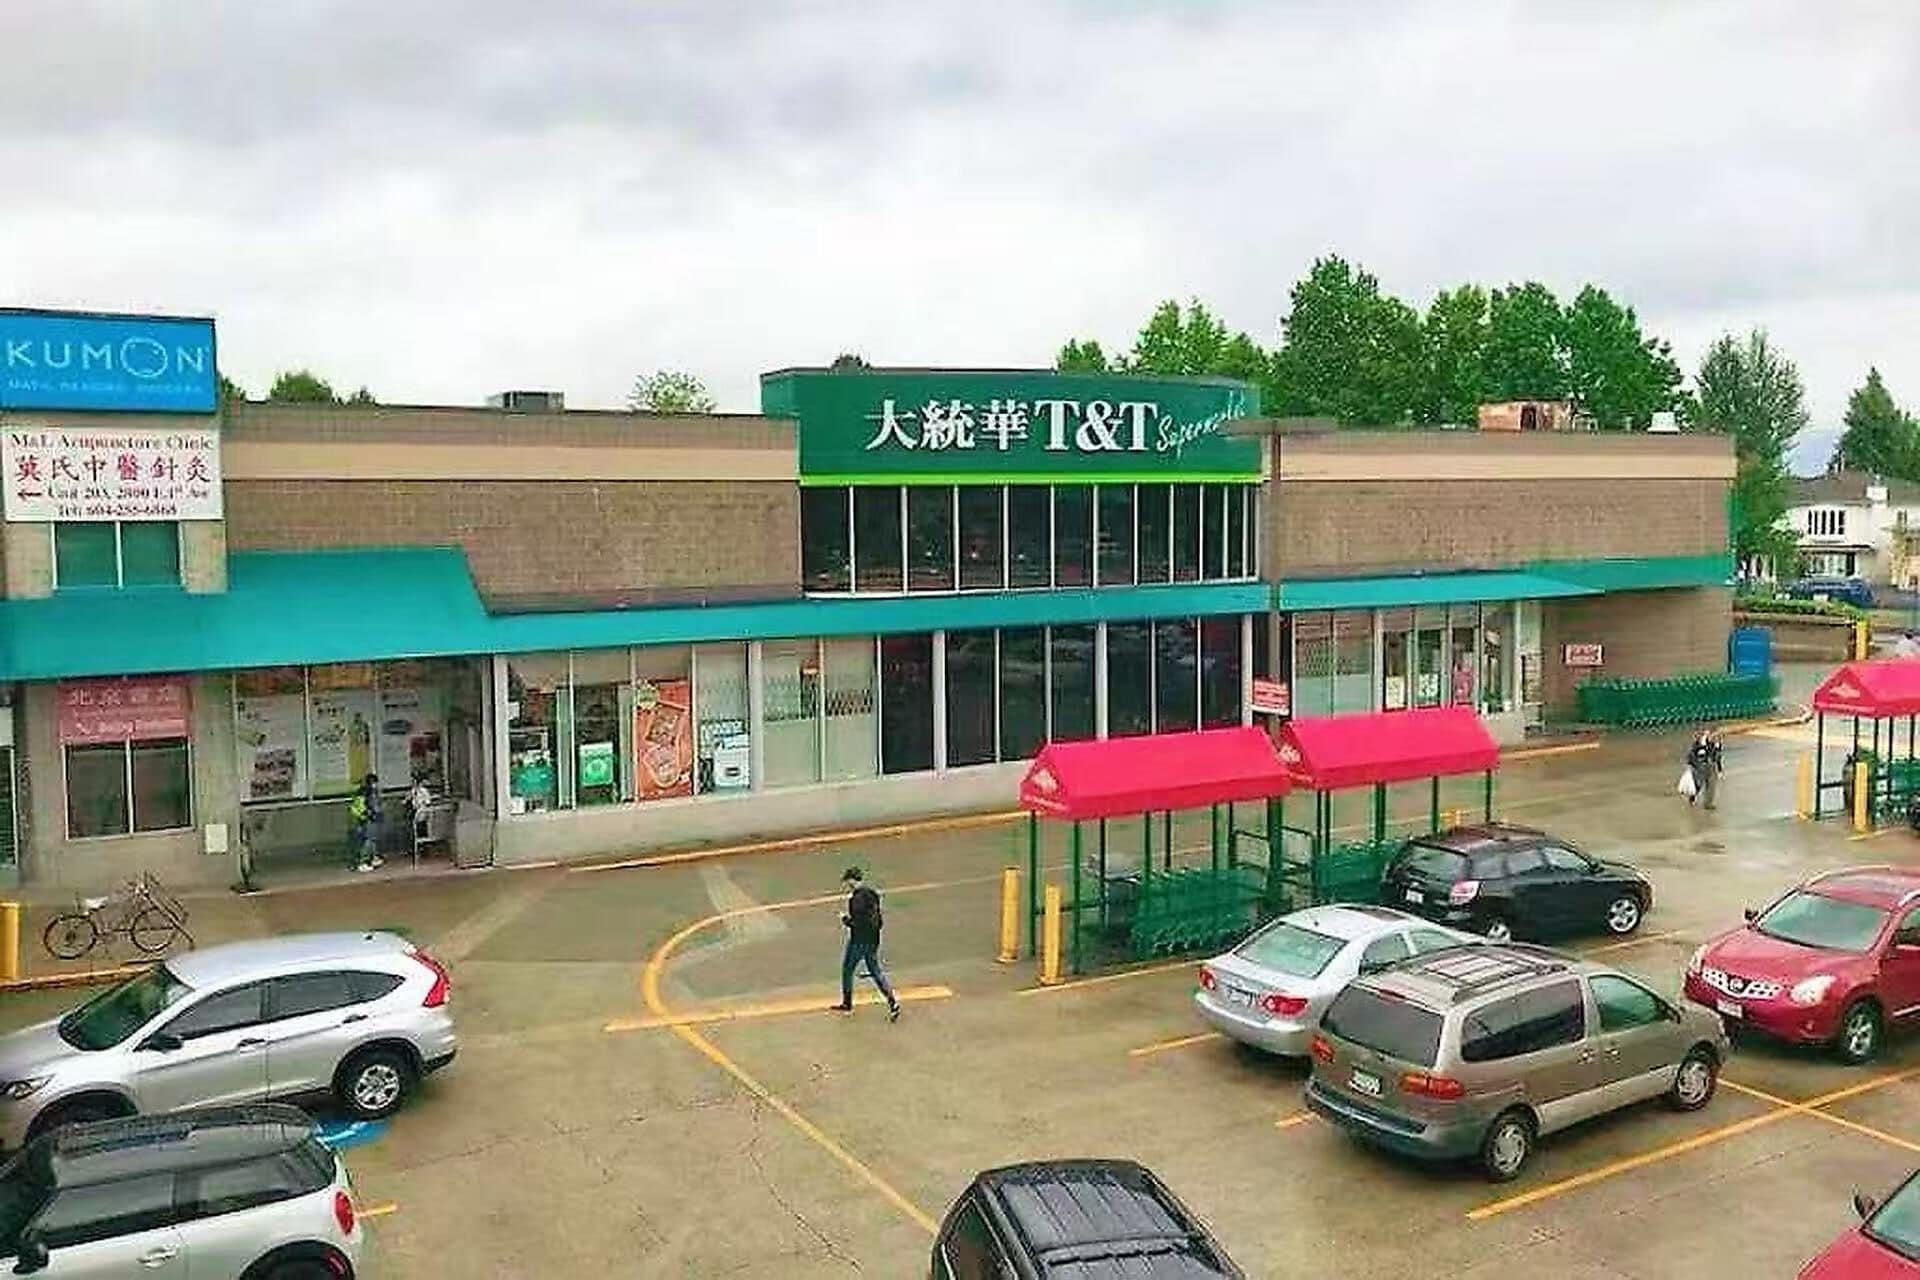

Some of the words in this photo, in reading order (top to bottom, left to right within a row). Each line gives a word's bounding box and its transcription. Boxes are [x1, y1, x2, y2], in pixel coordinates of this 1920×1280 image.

[6, 336, 204, 379] KUMON
[864, 398, 1029, 451] 大統華
[1034, 399, 1158, 451] T&T
